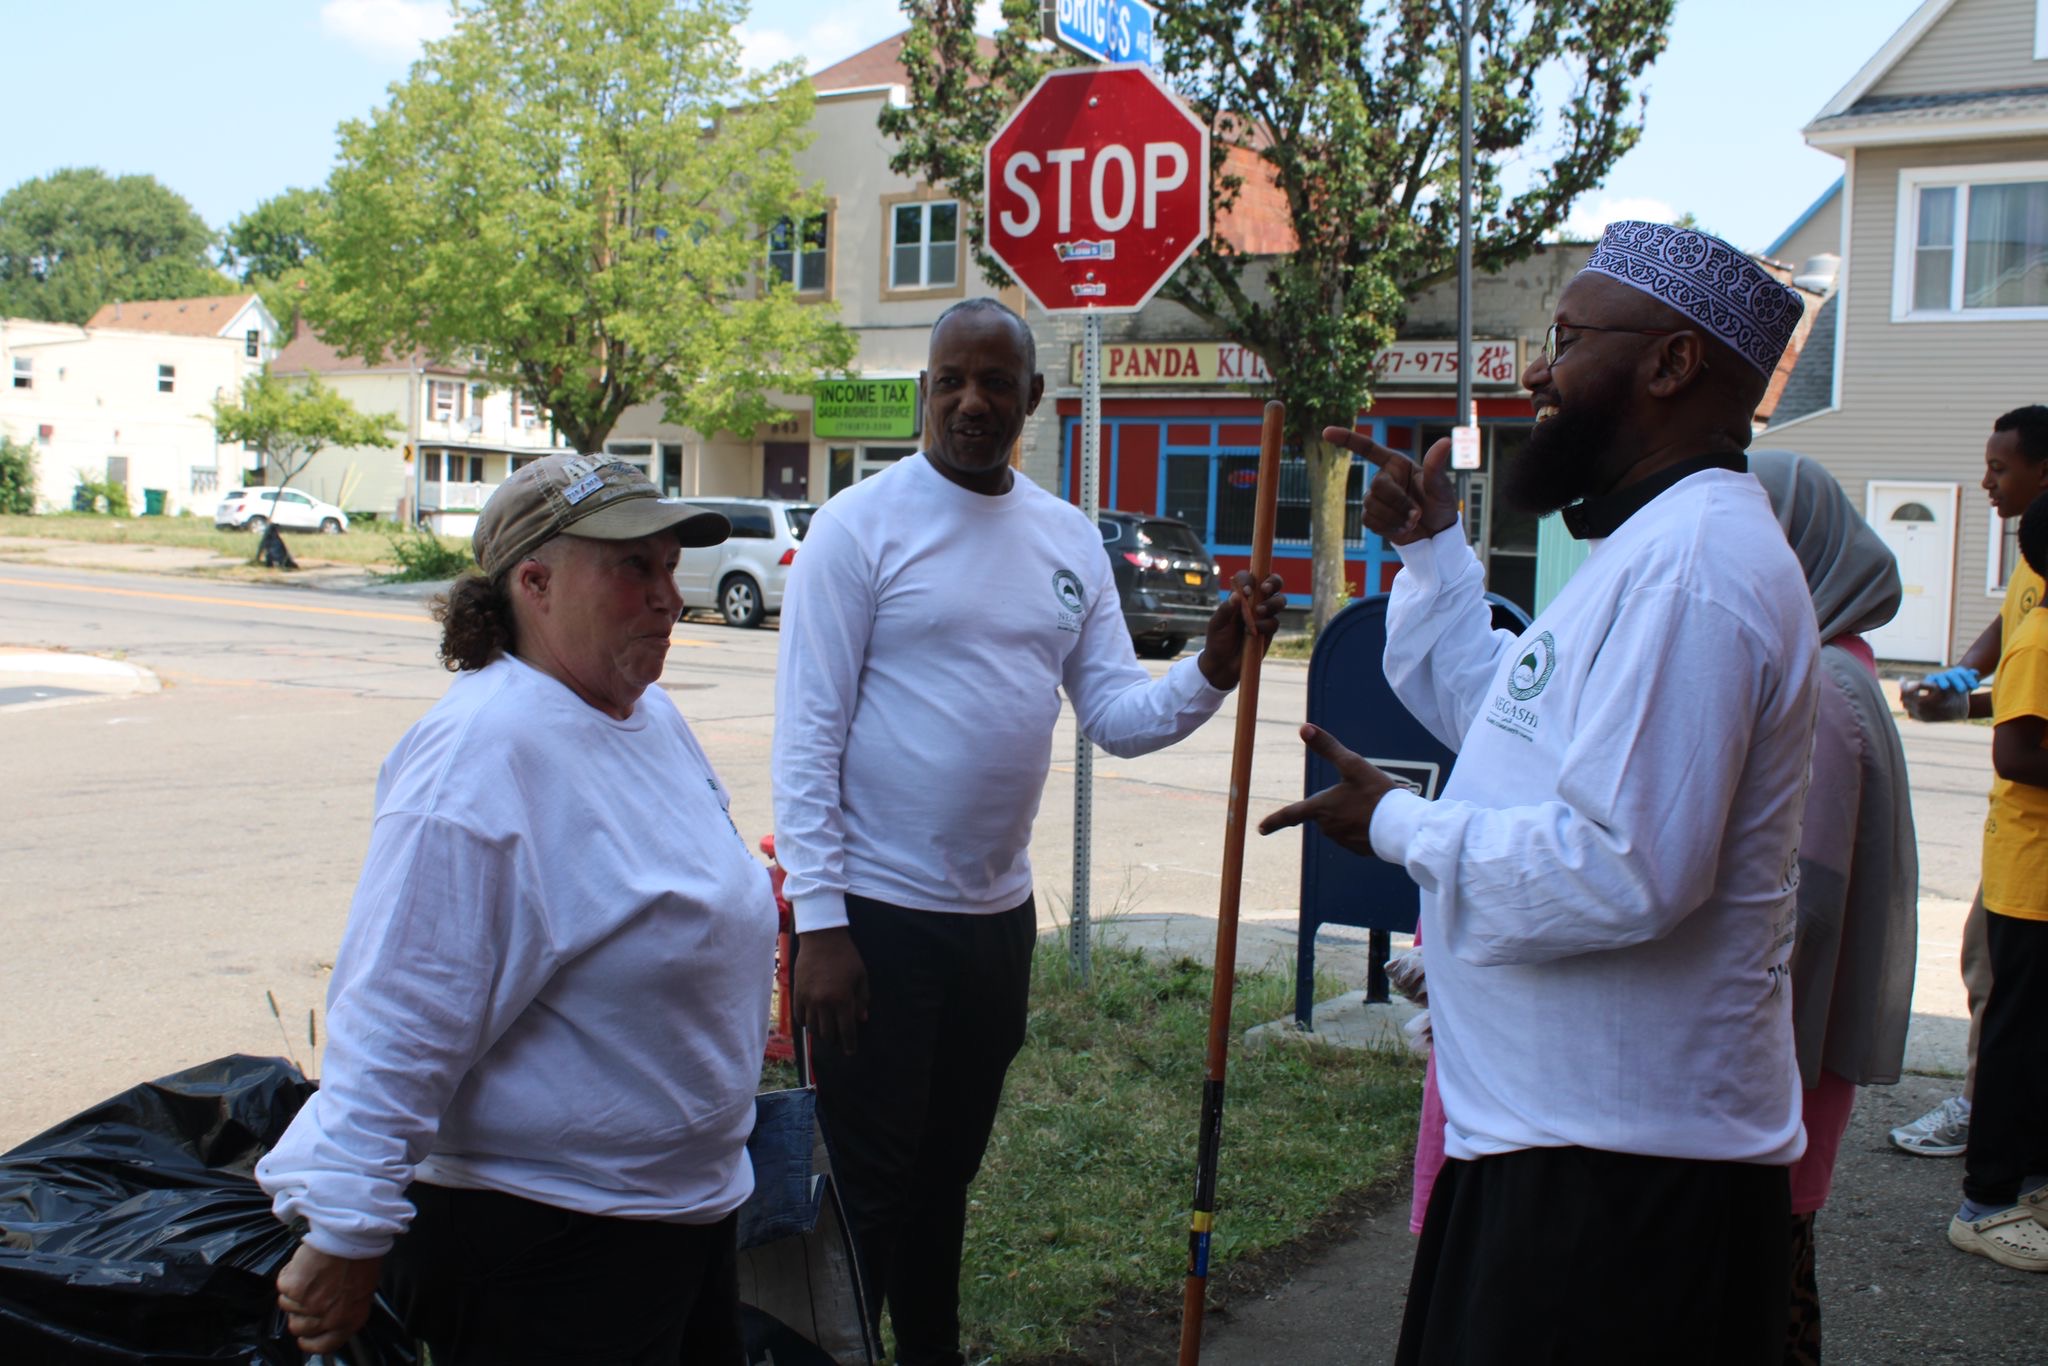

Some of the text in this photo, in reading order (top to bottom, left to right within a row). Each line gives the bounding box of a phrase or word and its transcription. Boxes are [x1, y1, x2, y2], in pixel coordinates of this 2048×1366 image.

[1000, 141, 1189, 238] STOP
[1108, 347, 1200, 377] PANDA
[1216, 347, 1275, 378] KIT
[1366, 351, 1474, 373] 47-975
[820, 383, 908, 403] INCOME TAX
